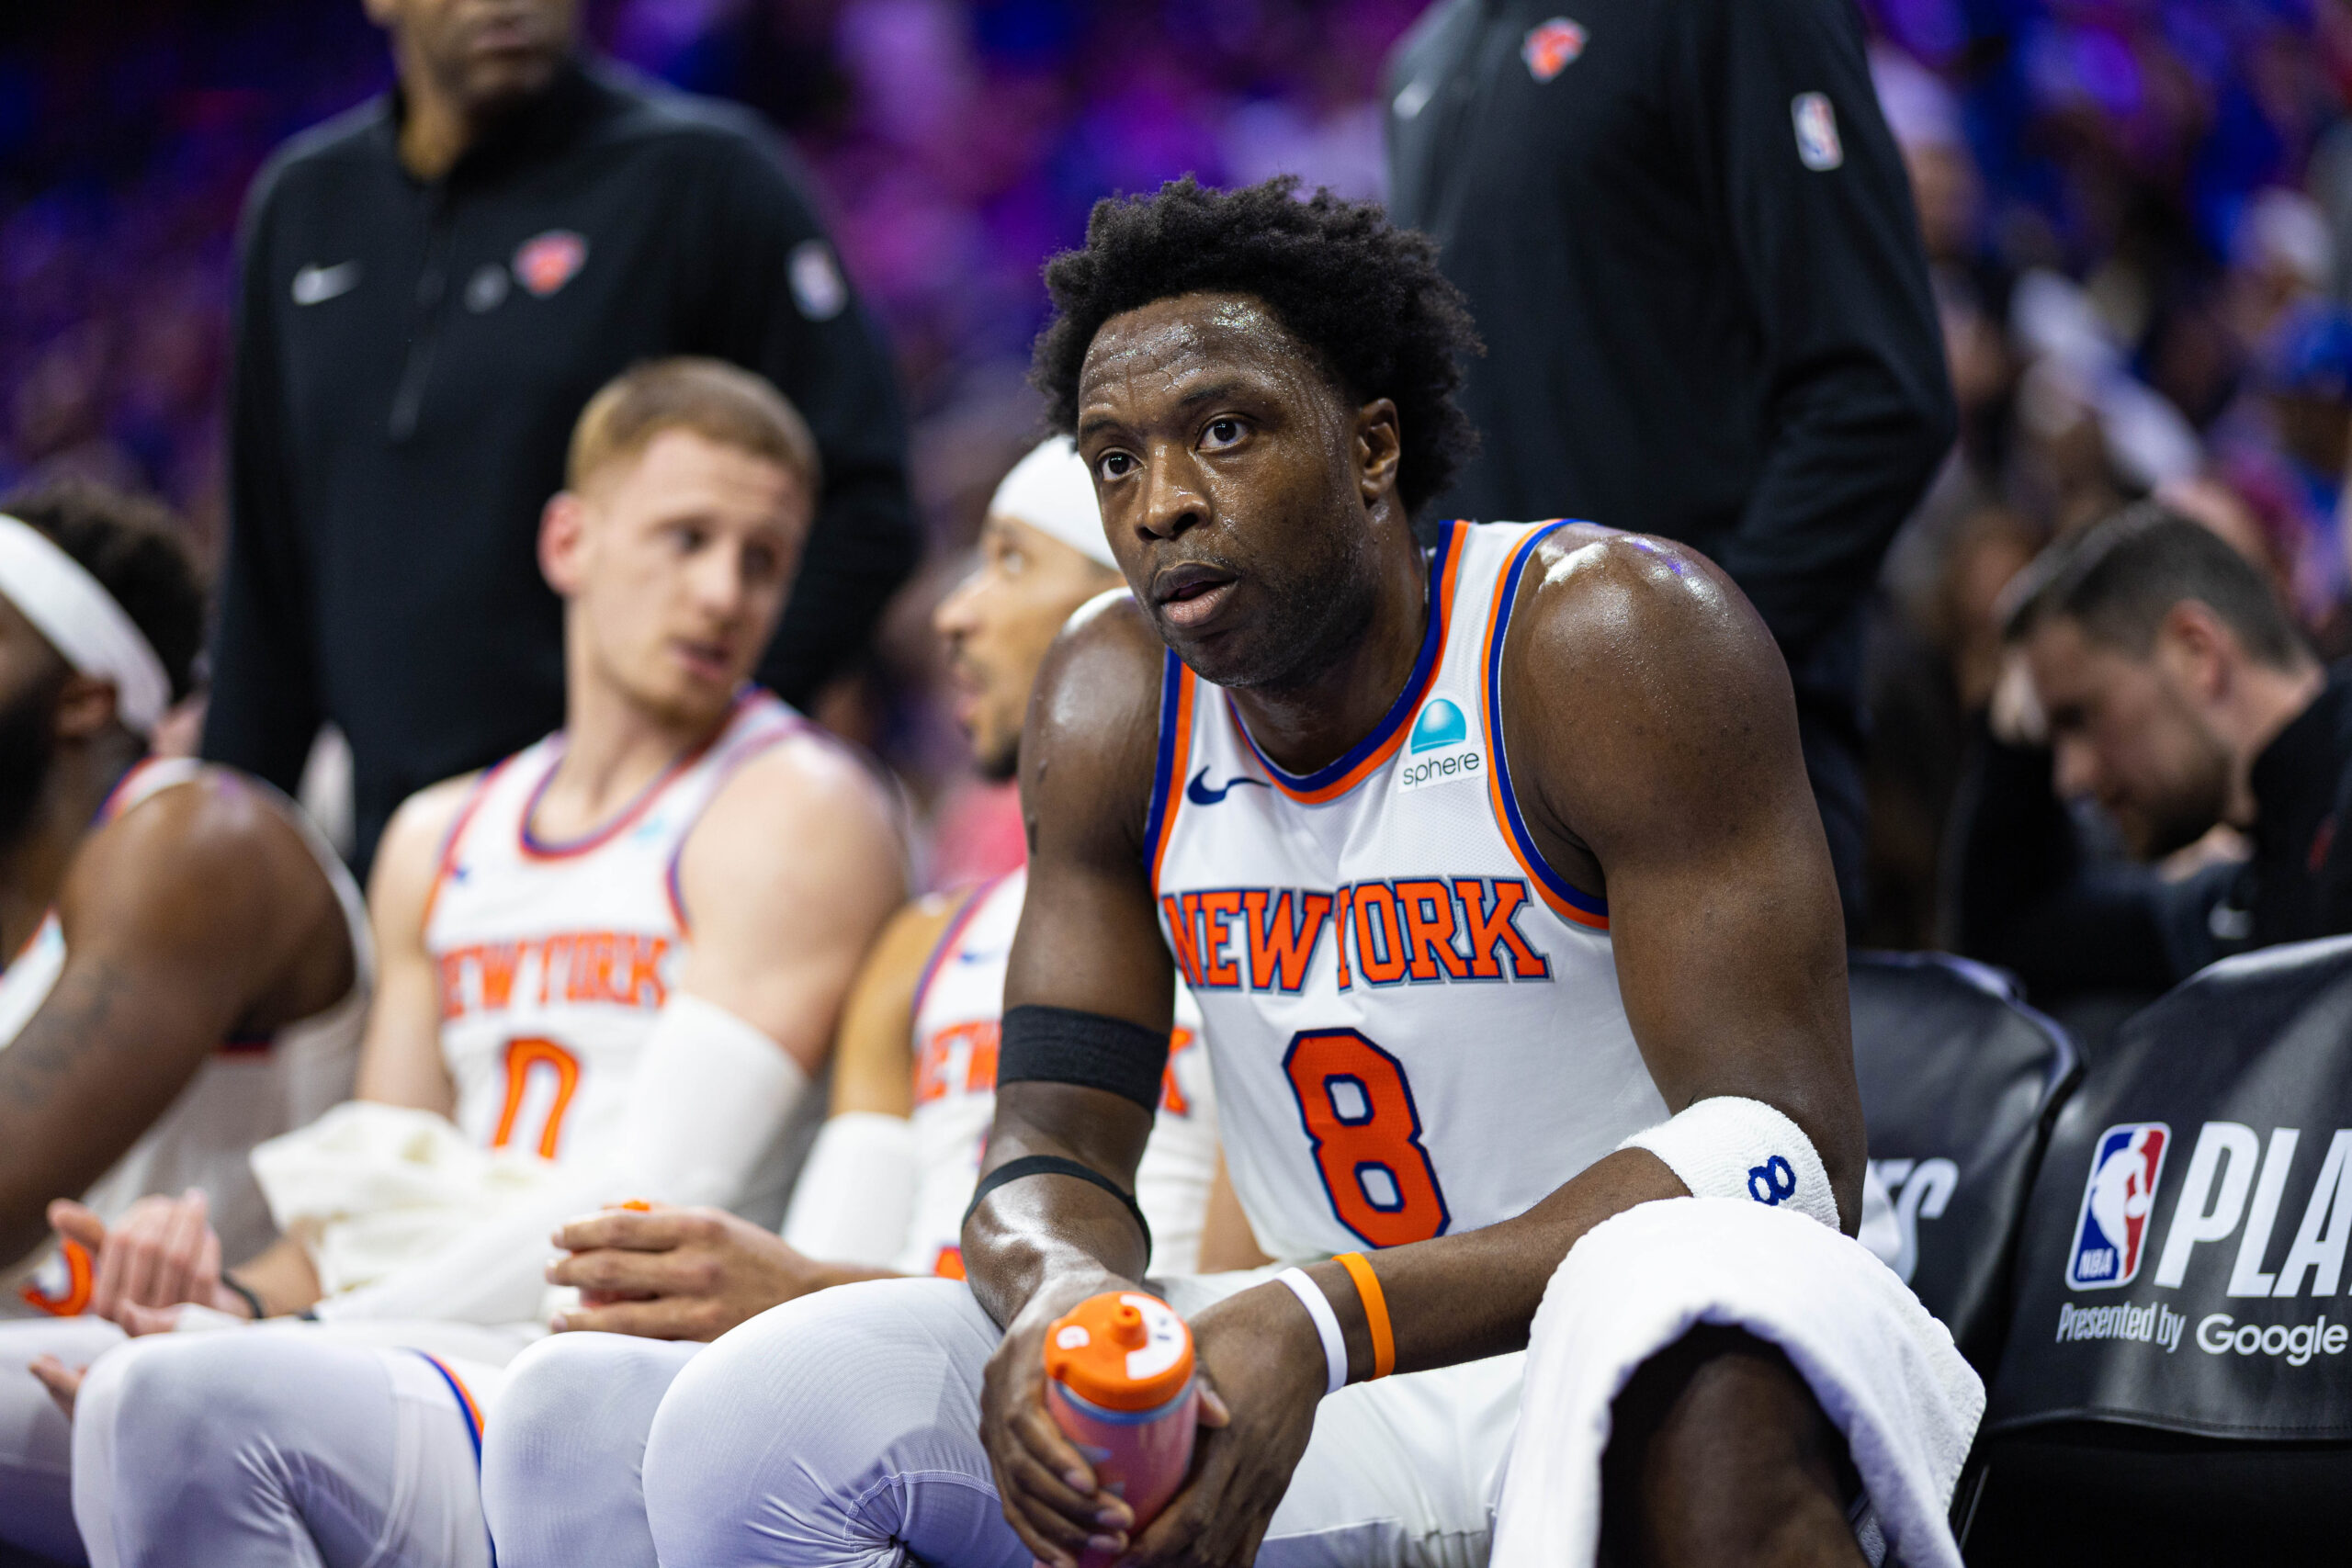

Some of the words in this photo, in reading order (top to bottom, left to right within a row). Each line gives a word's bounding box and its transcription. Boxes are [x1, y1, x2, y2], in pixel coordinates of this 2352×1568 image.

[1403, 752, 1479, 787] sphere
[1159, 886, 1338, 996] NEW
[1335, 874, 1555, 994] YORK
[440, 941, 526, 1022] EW
[1282, 1027, 1452, 1249] 8
[1747, 1155, 1797, 1206] 8
[2154, 1120, 2352, 1298] PLA
[2076, 1247, 2115, 1280] NBA
[2055, 1301, 2158, 1344] Presented
[2155, 1303, 2188, 1354] by
[2195, 1313, 2349, 1367] Google
